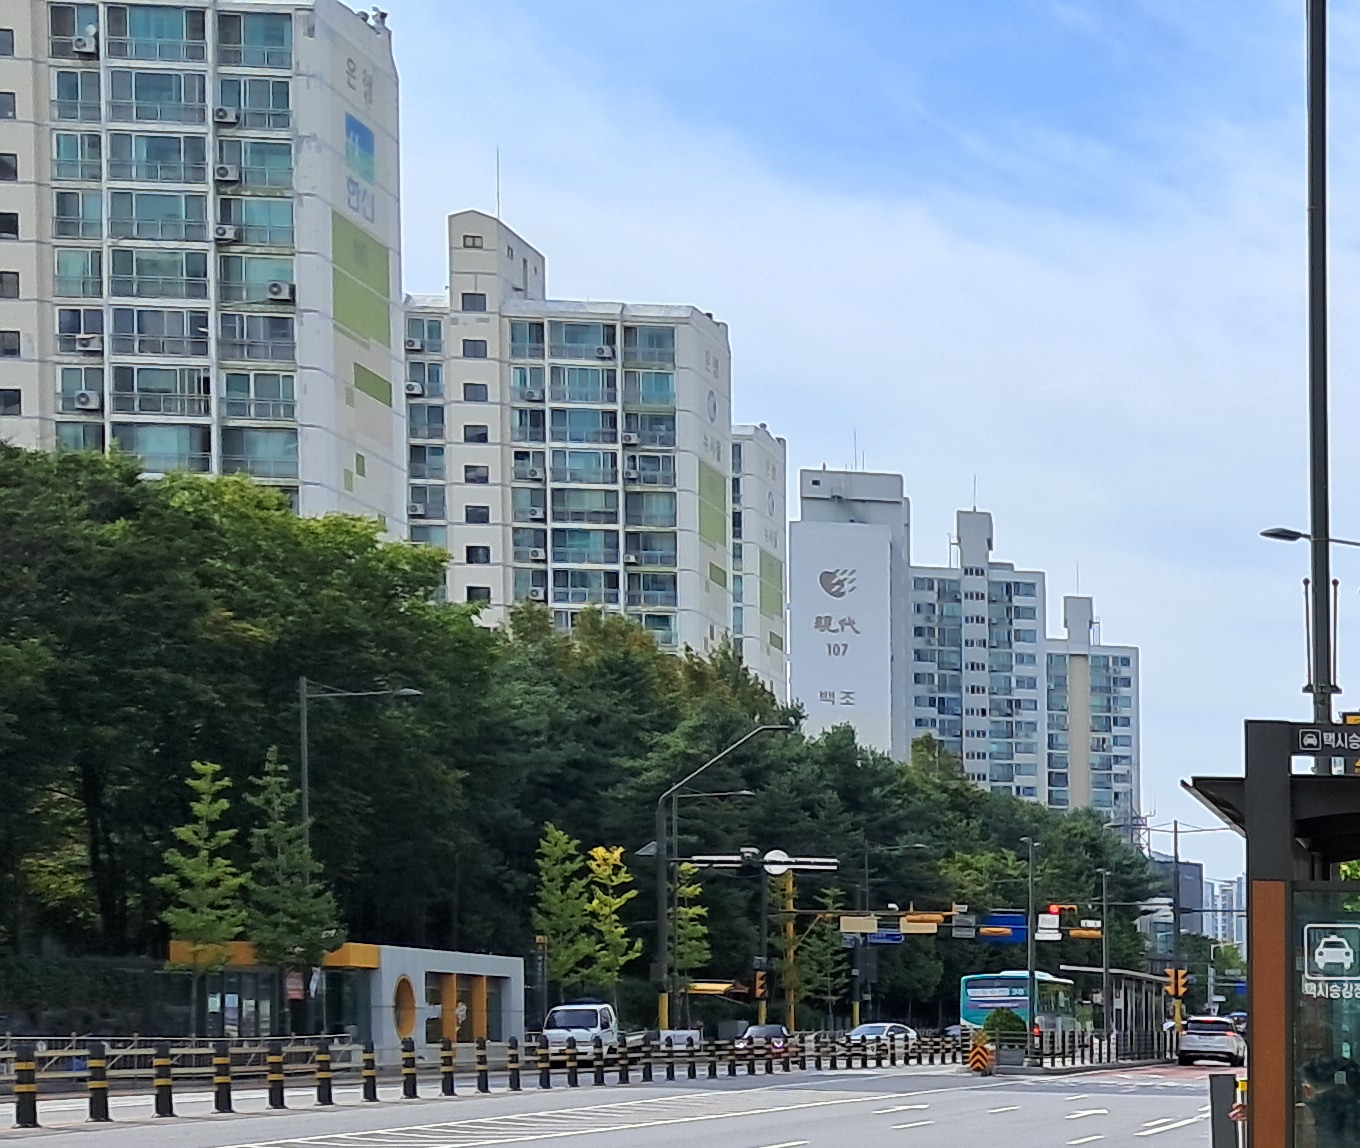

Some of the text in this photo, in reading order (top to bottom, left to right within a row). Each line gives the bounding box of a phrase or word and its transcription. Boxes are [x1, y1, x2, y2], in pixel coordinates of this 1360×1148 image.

[346, 175, 375, 224] 한신
[814, 615, 860, 635] 現代
[826, 643, 849, 657] 107
[819, 690, 856, 706] 백조
